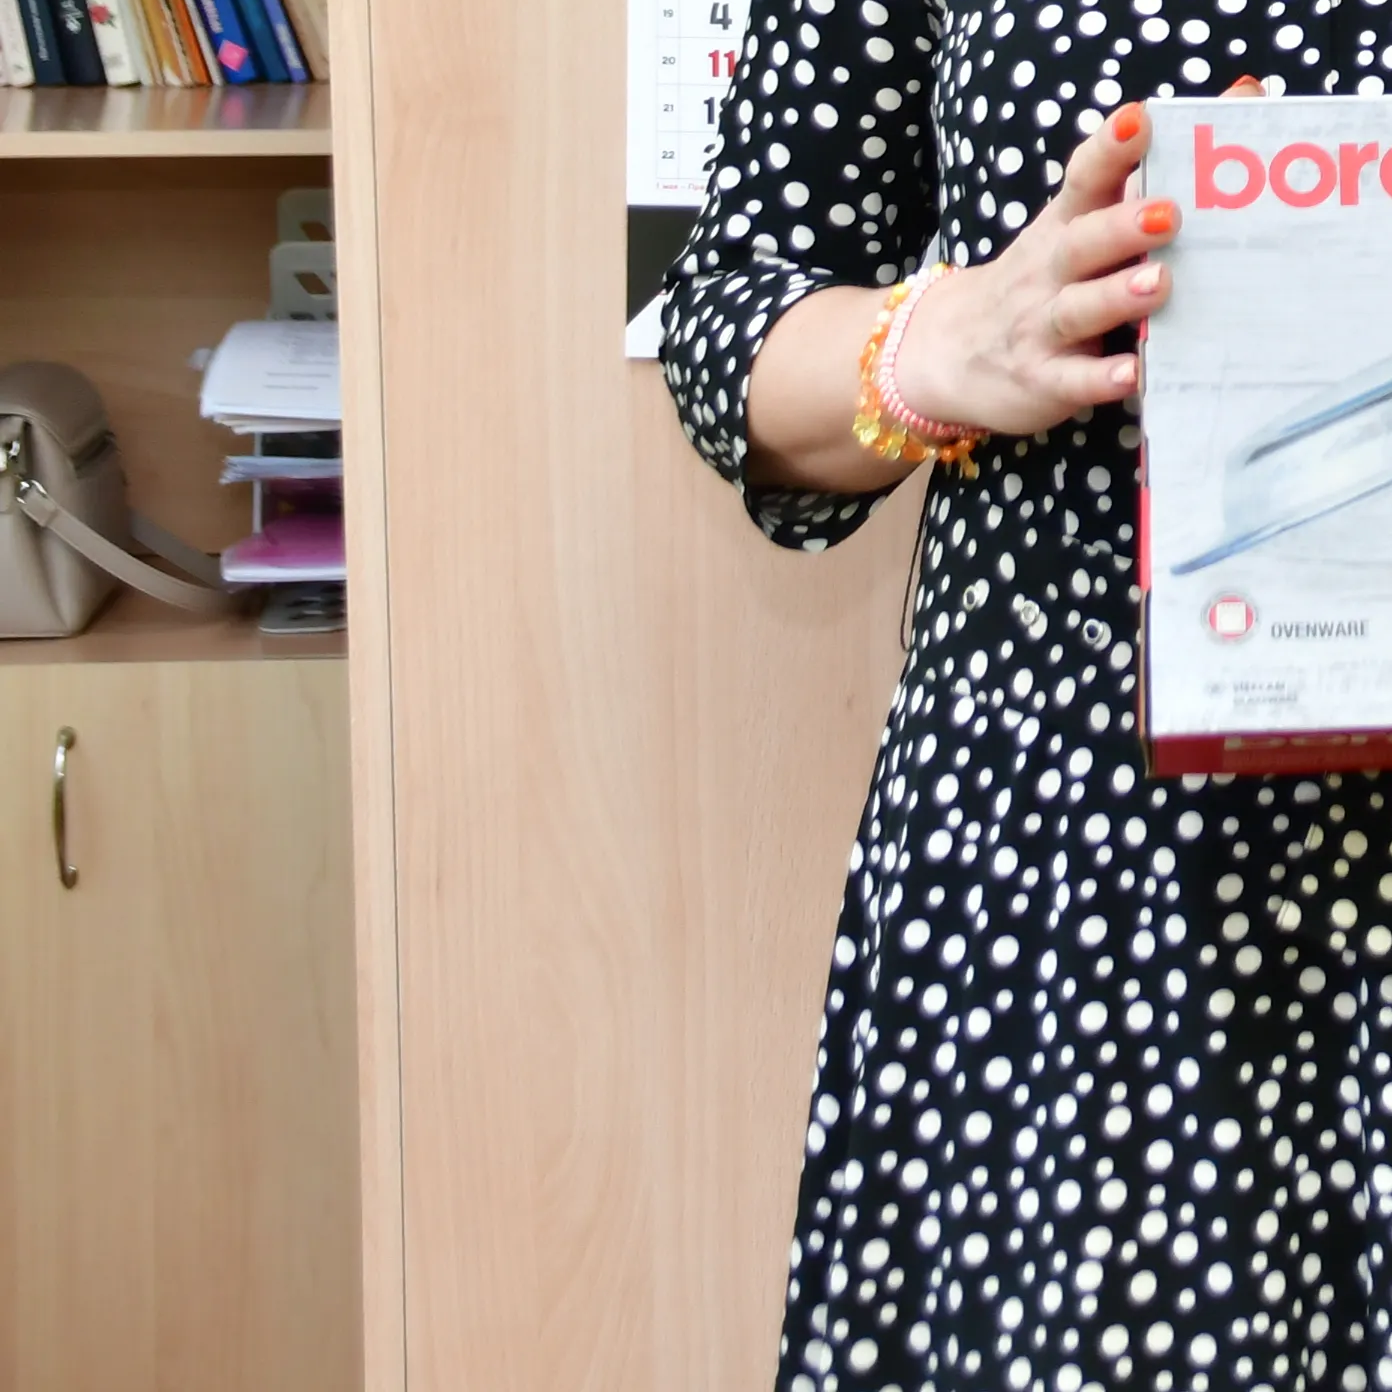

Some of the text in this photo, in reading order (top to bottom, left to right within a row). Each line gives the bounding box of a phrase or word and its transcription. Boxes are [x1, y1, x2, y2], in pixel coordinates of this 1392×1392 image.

[663, 2, 733, 31] 19 4
[662, 49, 737, 78] 20 11
[663, 103, 675, 113] 21
[662, 150, 676, 160] 22
[1270, 619, 1370, 639] OVENWARE
